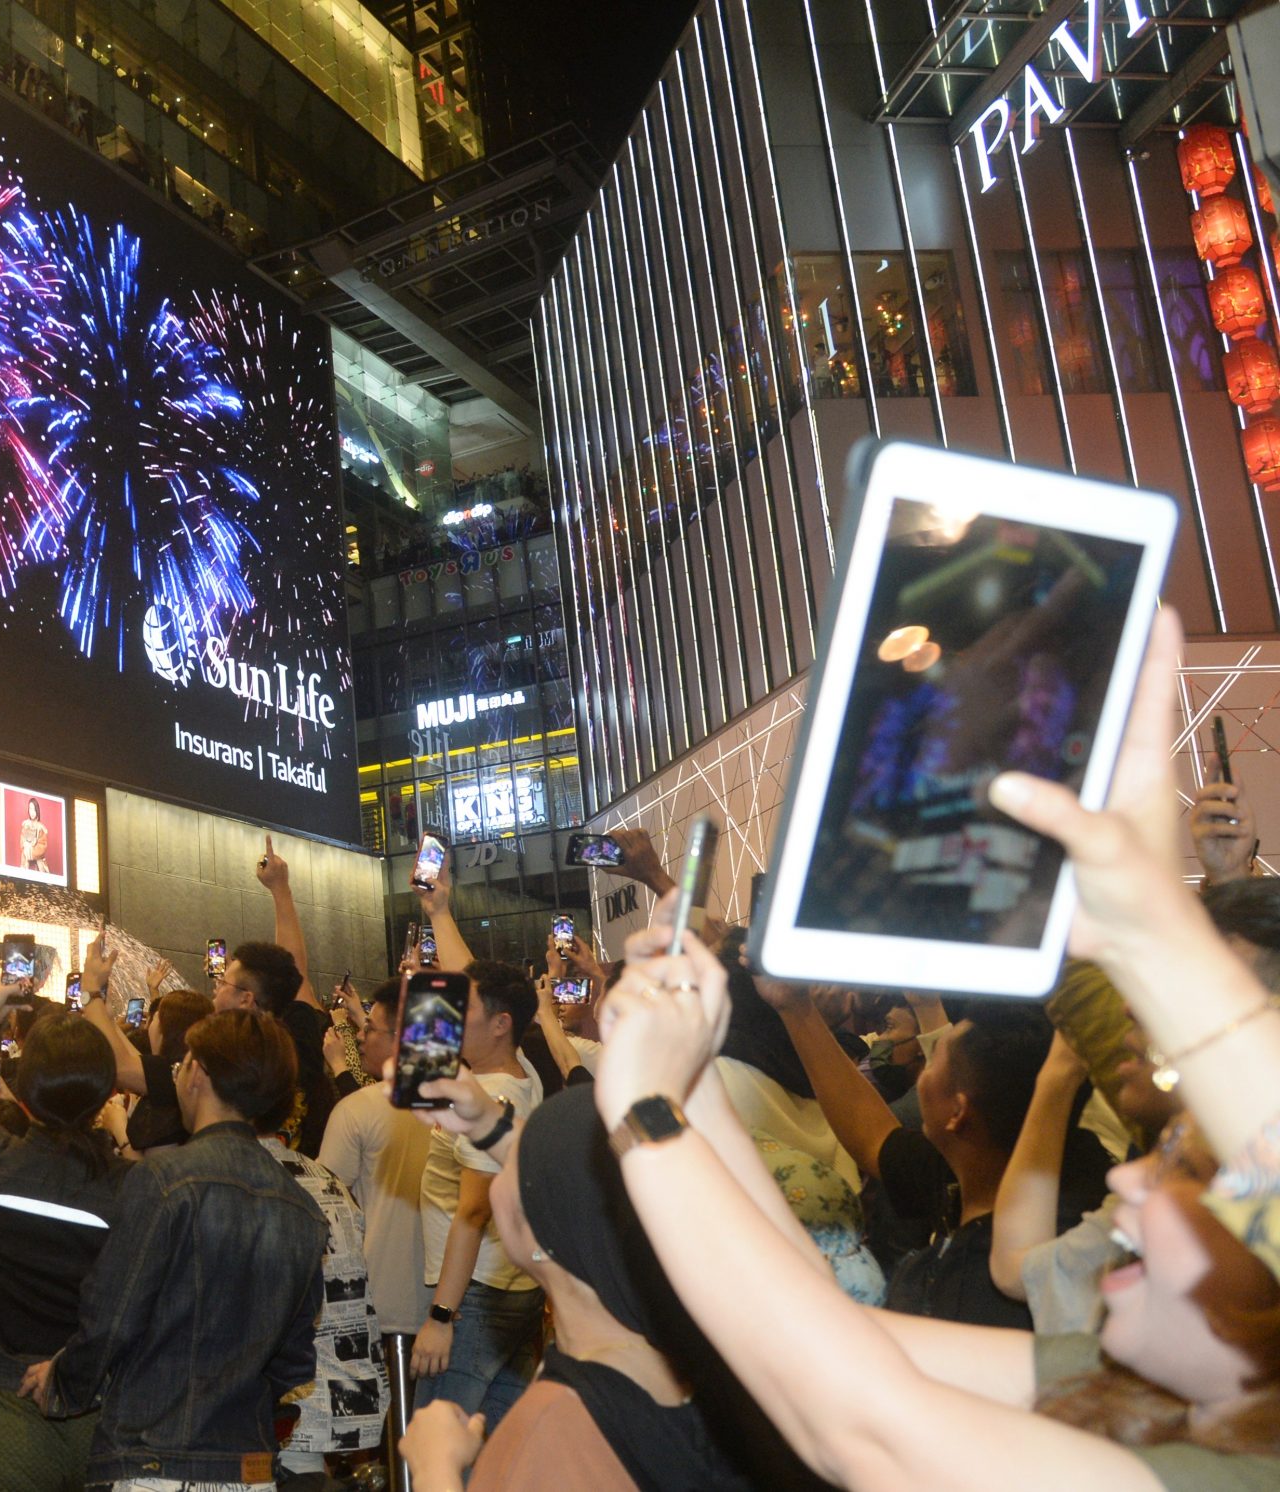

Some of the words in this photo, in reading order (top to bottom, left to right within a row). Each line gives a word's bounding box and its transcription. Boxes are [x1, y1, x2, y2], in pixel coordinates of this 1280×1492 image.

[360, 197, 552, 284] CONNECTION
[206, 636, 274, 707] Sun
[275, 662, 336, 729] Life
[416, 693, 477, 730] MUJI
[174, 721, 254, 771] Insurans
[267, 751, 328, 794] Takaful
[465, 842, 498, 868] JD
[605, 884, 639, 923] DIOR
